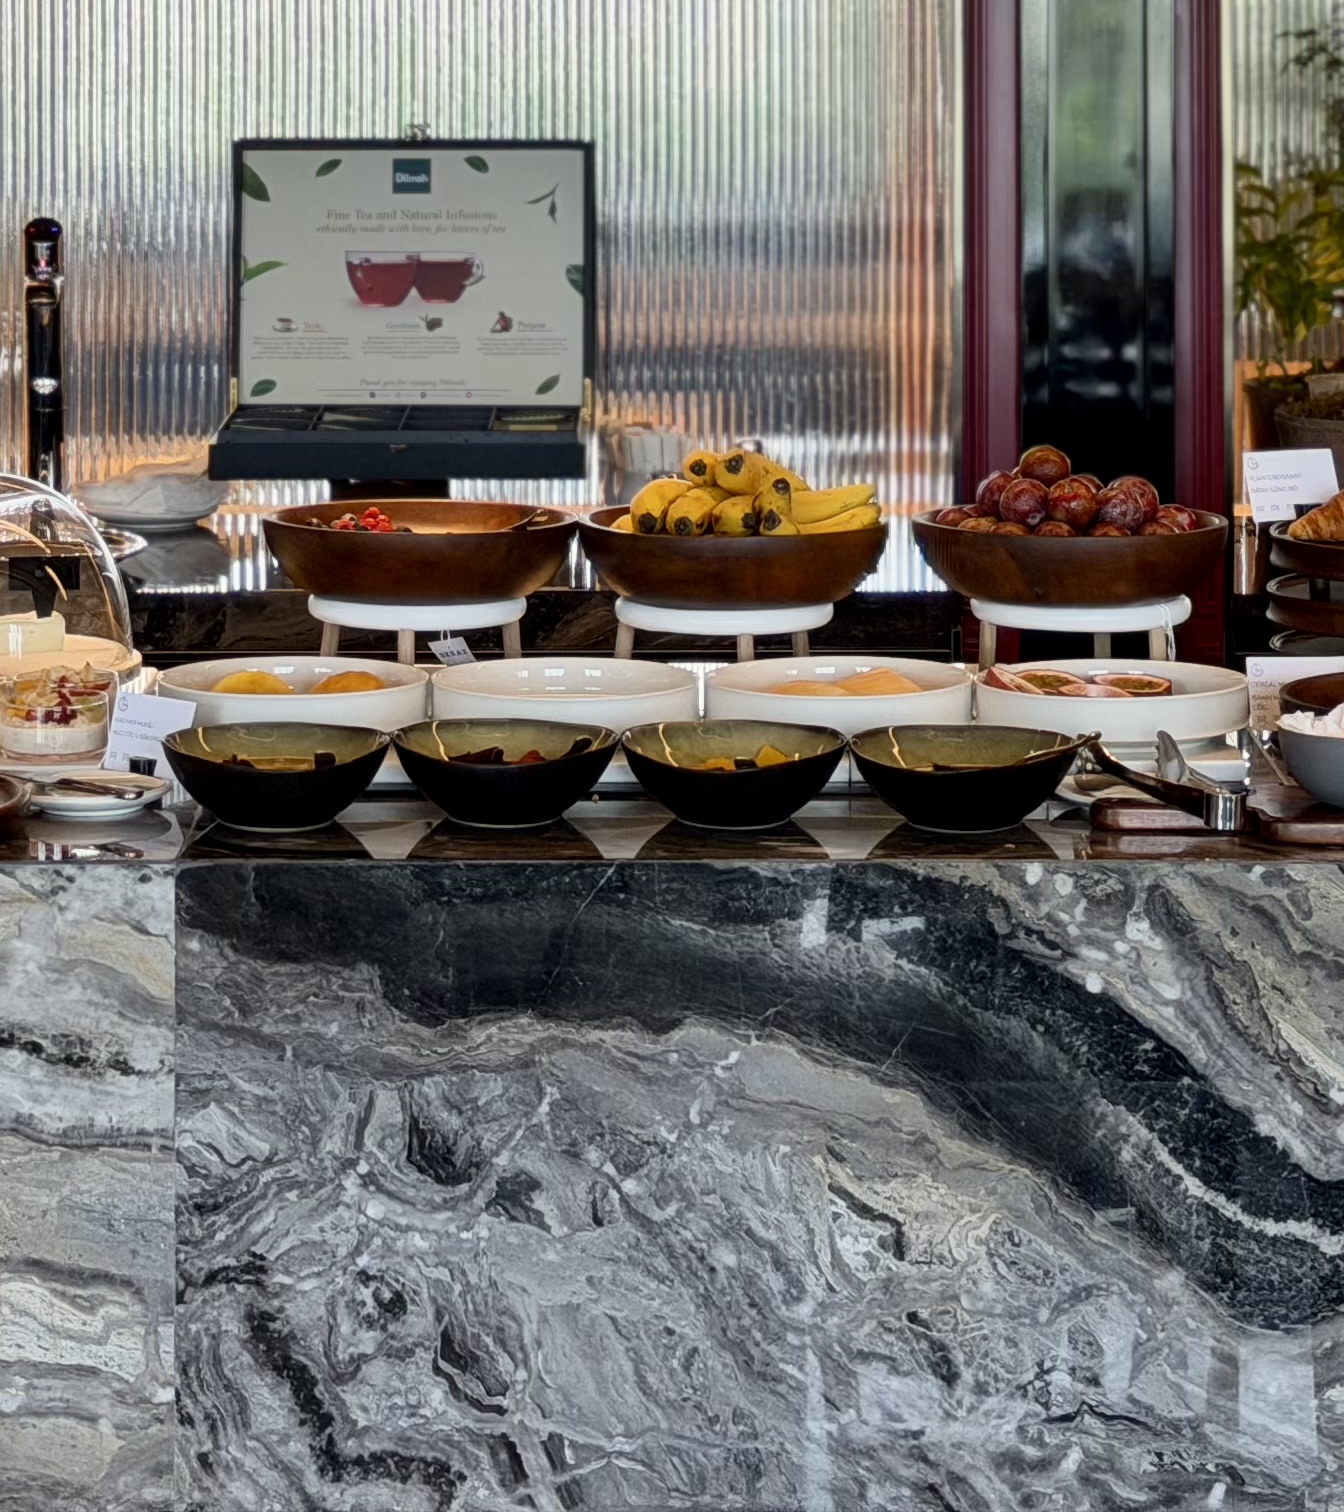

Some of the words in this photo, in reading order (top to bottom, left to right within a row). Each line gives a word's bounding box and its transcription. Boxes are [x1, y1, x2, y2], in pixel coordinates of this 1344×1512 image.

[395, 172, 429, 183] Dilmah
[327, 209, 352, 220] Fine
[354, 209, 373, 220] Tea
[376, 209, 397, 220] and
[400, 209, 442, 220] Natural
[446, 209, 498, 220] Infusions
